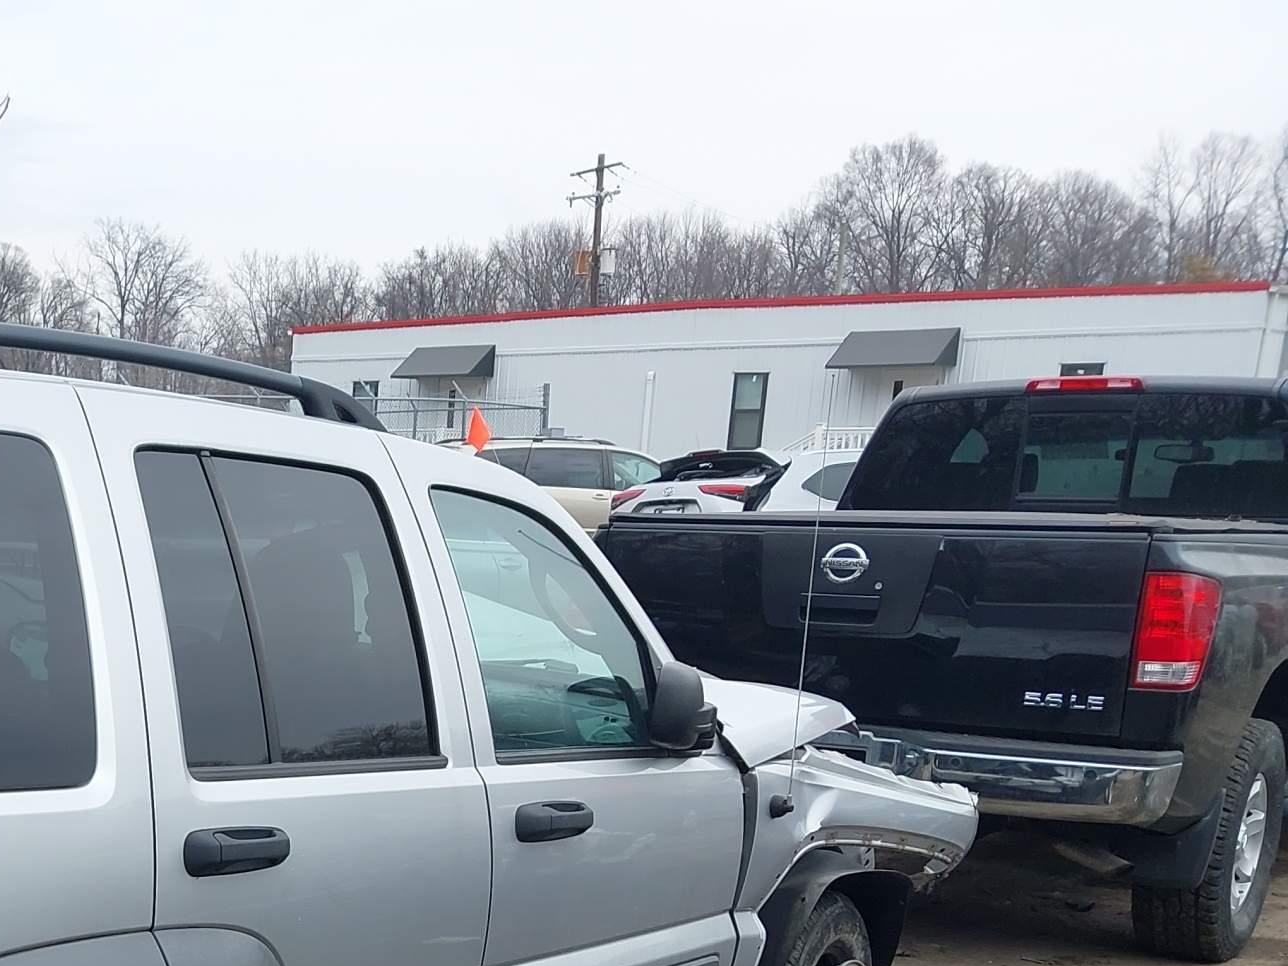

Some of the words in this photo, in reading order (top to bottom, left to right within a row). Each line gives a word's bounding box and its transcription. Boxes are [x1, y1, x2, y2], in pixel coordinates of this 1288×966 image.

[825, 558, 864, 569] NISSAN
[1023, 691, 1063, 708] 5.6
[1069, 694, 1105, 711] LE
